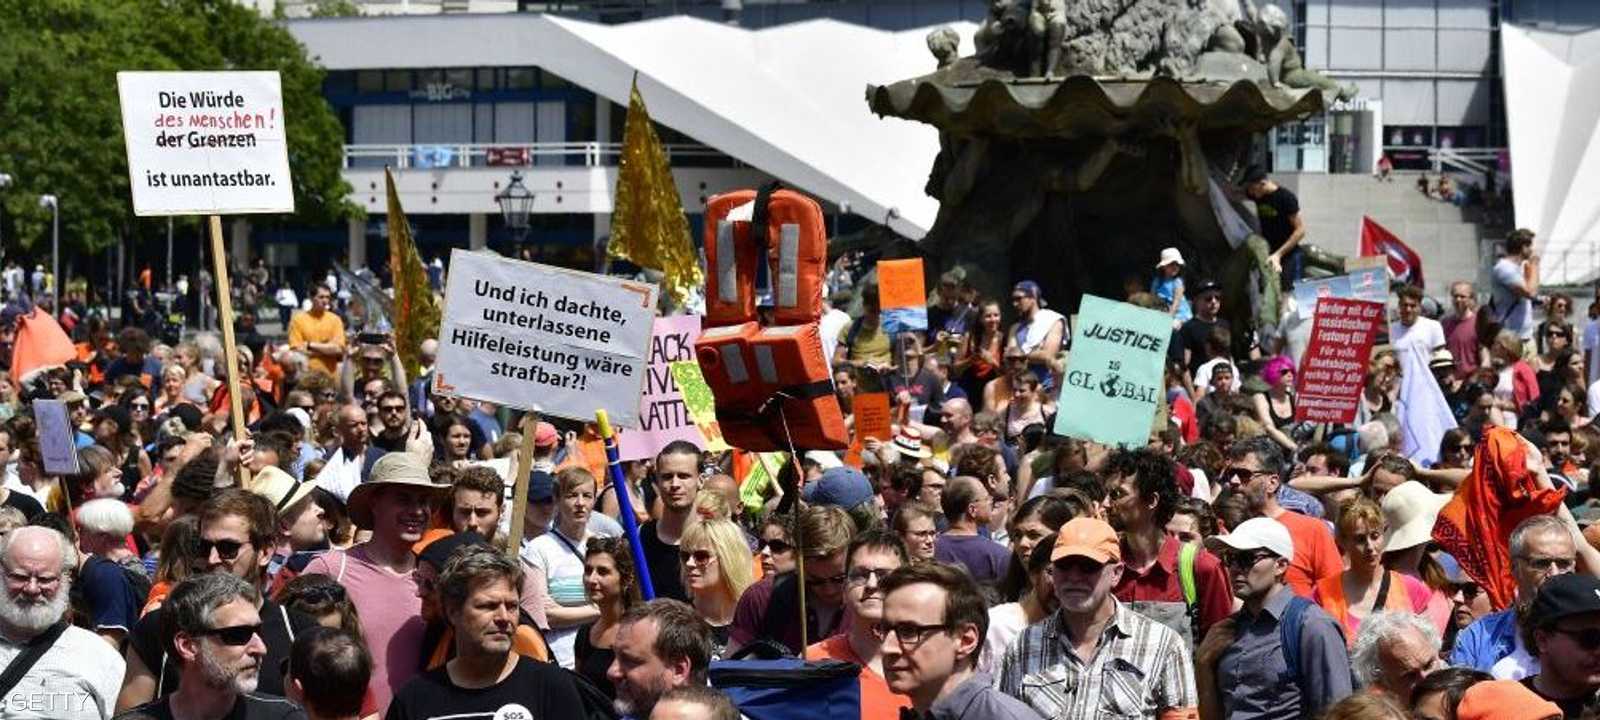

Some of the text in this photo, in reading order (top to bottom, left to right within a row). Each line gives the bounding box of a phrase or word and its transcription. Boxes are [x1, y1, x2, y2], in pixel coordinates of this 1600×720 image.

[158, 90, 245, 109] Die Würde
[154, 113, 184, 128] des
[156, 130, 257, 150] der Grenzen
[146, 169, 275, 187] ist unantastbar.
[474, 279, 627, 327] Und ich dachte,
[482, 307, 611, 344] unterlassene
[1083, 322, 1163, 352] JUSTICE
[451, 328, 633, 377] Hilfeleistung wäre
[648, 331, 692, 365] ACK
[490, 361, 587, 391] strafbar?!
[639, 399, 695, 431] ATTE
[503, 712, 524, 720] SOS
